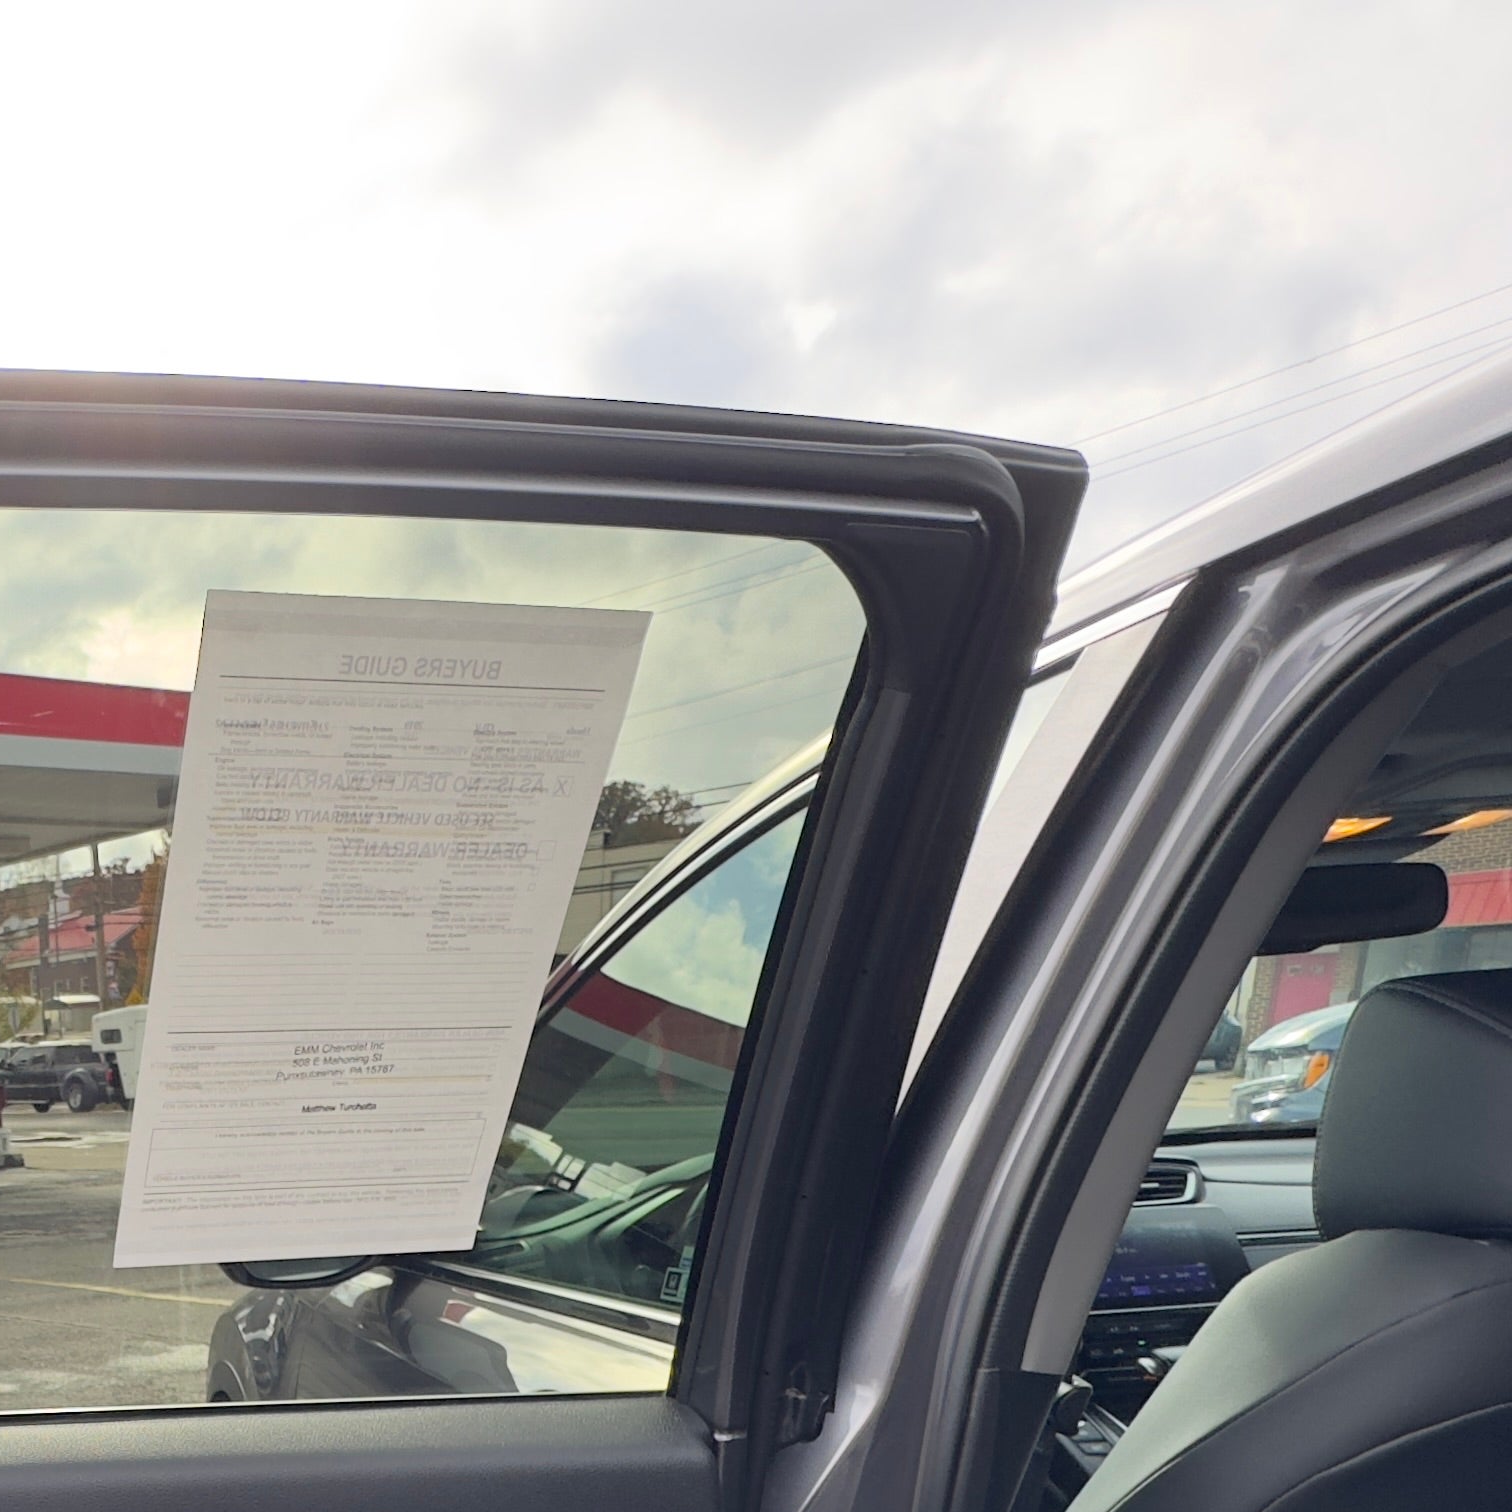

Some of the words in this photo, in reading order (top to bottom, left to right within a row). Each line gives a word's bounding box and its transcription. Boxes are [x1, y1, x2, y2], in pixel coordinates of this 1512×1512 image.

[294, 1045, 320, 1056] EMM
[322, 1043, 368, 1054] Chevrolet
[370, 1042, 385, 1051] Inc
[313, 1057, 321, 1066] E
[323, 1055, 370, 1066] Mahoning
[371, 1053, 383, 1062] St
